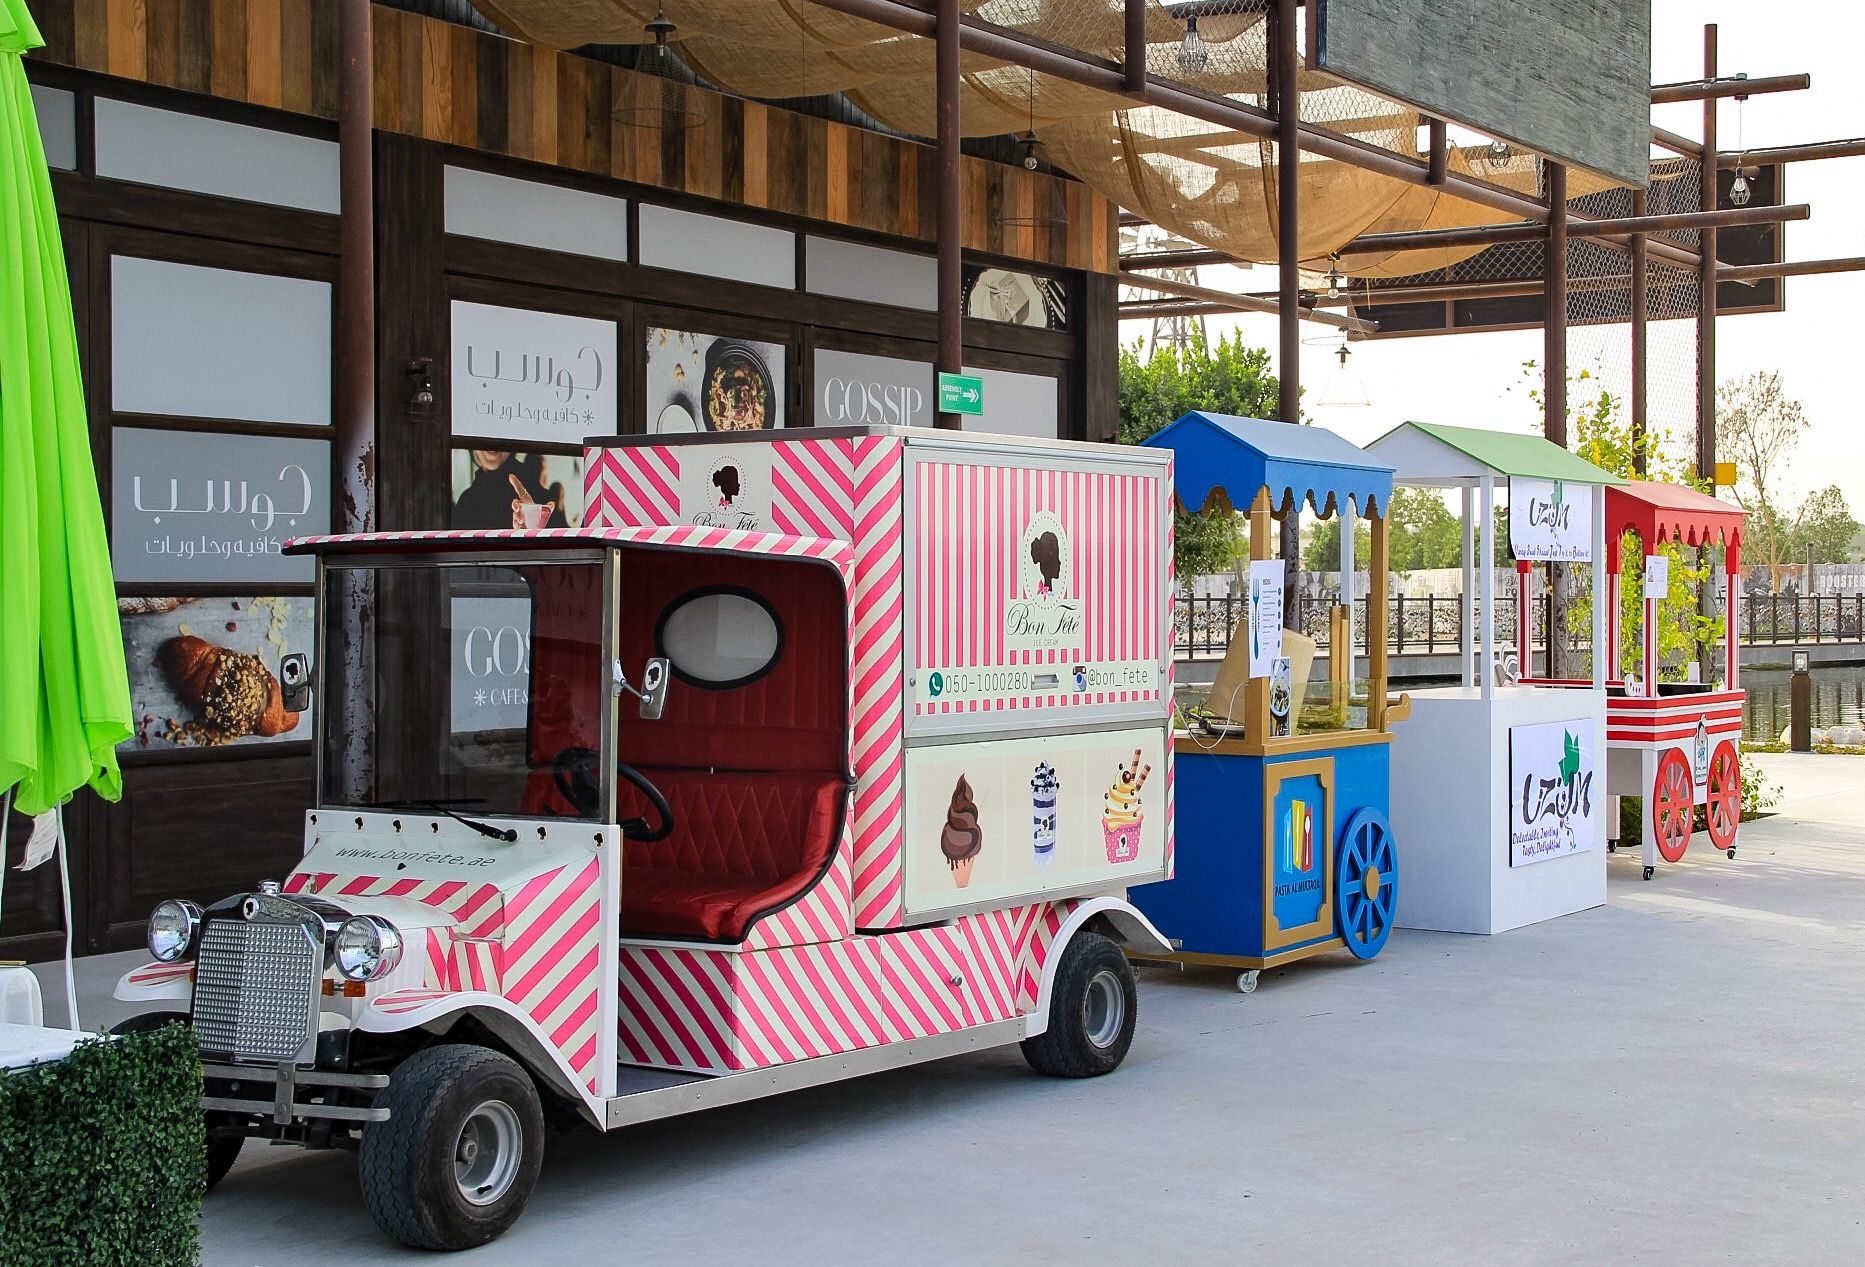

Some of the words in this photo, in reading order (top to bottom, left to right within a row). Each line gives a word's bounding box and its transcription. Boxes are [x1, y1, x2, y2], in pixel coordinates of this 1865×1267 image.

[468, 346, 602, 402] جوسب
[824, 377, 922, 426] GOSSIP
[134, 464, 312, 532] جوسب
[1006, 603, 1044, 636] Bon
[1033, 639, 1041, 647] ICE
[1044, 638, 1059, 647] CREAM
[945, 671, 1029, 693] 050-1000280
[1087, 667, 1149, 687] @bon_fete
[1523, 770, 1593, 825] UZUM
[335, 848, 496, 867] www.bonfete.ae
